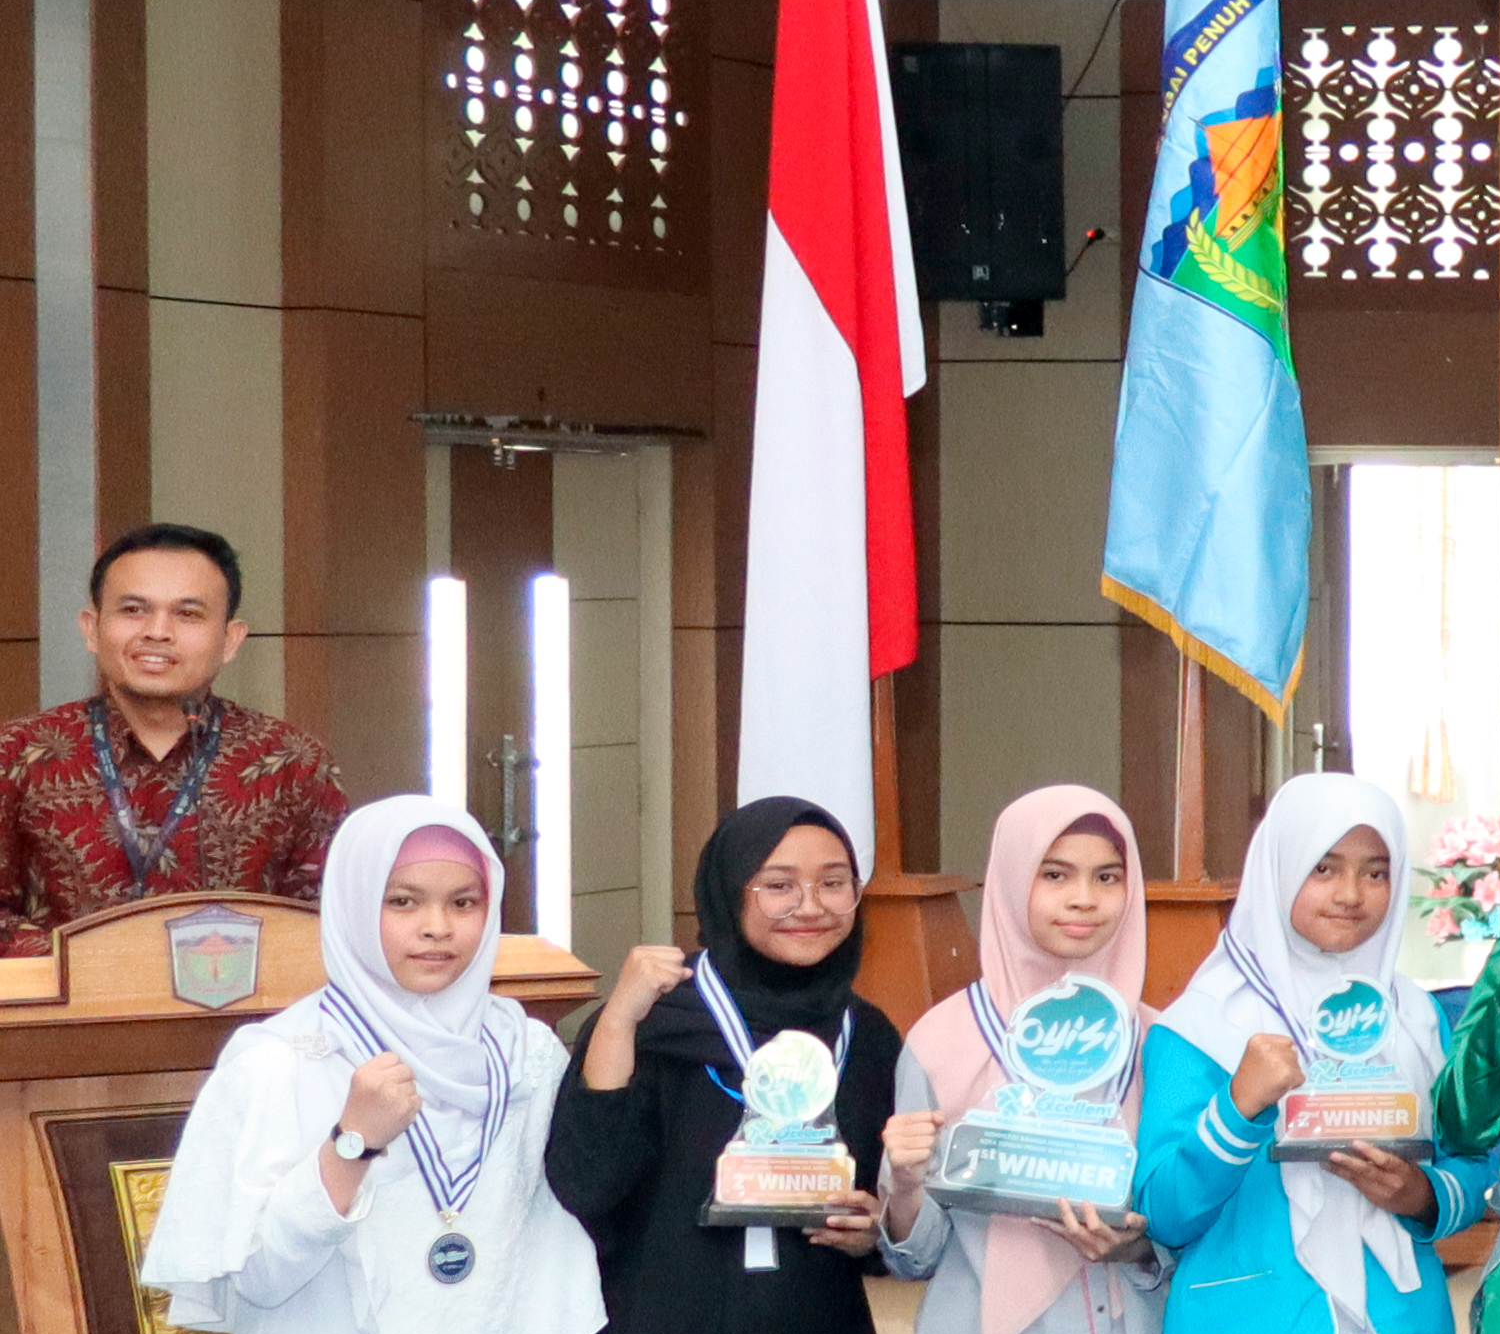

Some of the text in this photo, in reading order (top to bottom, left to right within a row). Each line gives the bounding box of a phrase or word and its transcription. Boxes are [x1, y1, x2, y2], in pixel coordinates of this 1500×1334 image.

[1316, 1001, 1389, 1037] Oyisi
[1016, 1016, 1119, 1056] Oyisi
[1036, 1097, 1116, 1118] Excellent
[1322, 1109, 1409, 1126] WINNER
[758, 1174, 843, 1191] WINNER
[966, 1148, 1117, 1189] 1st WINNER
